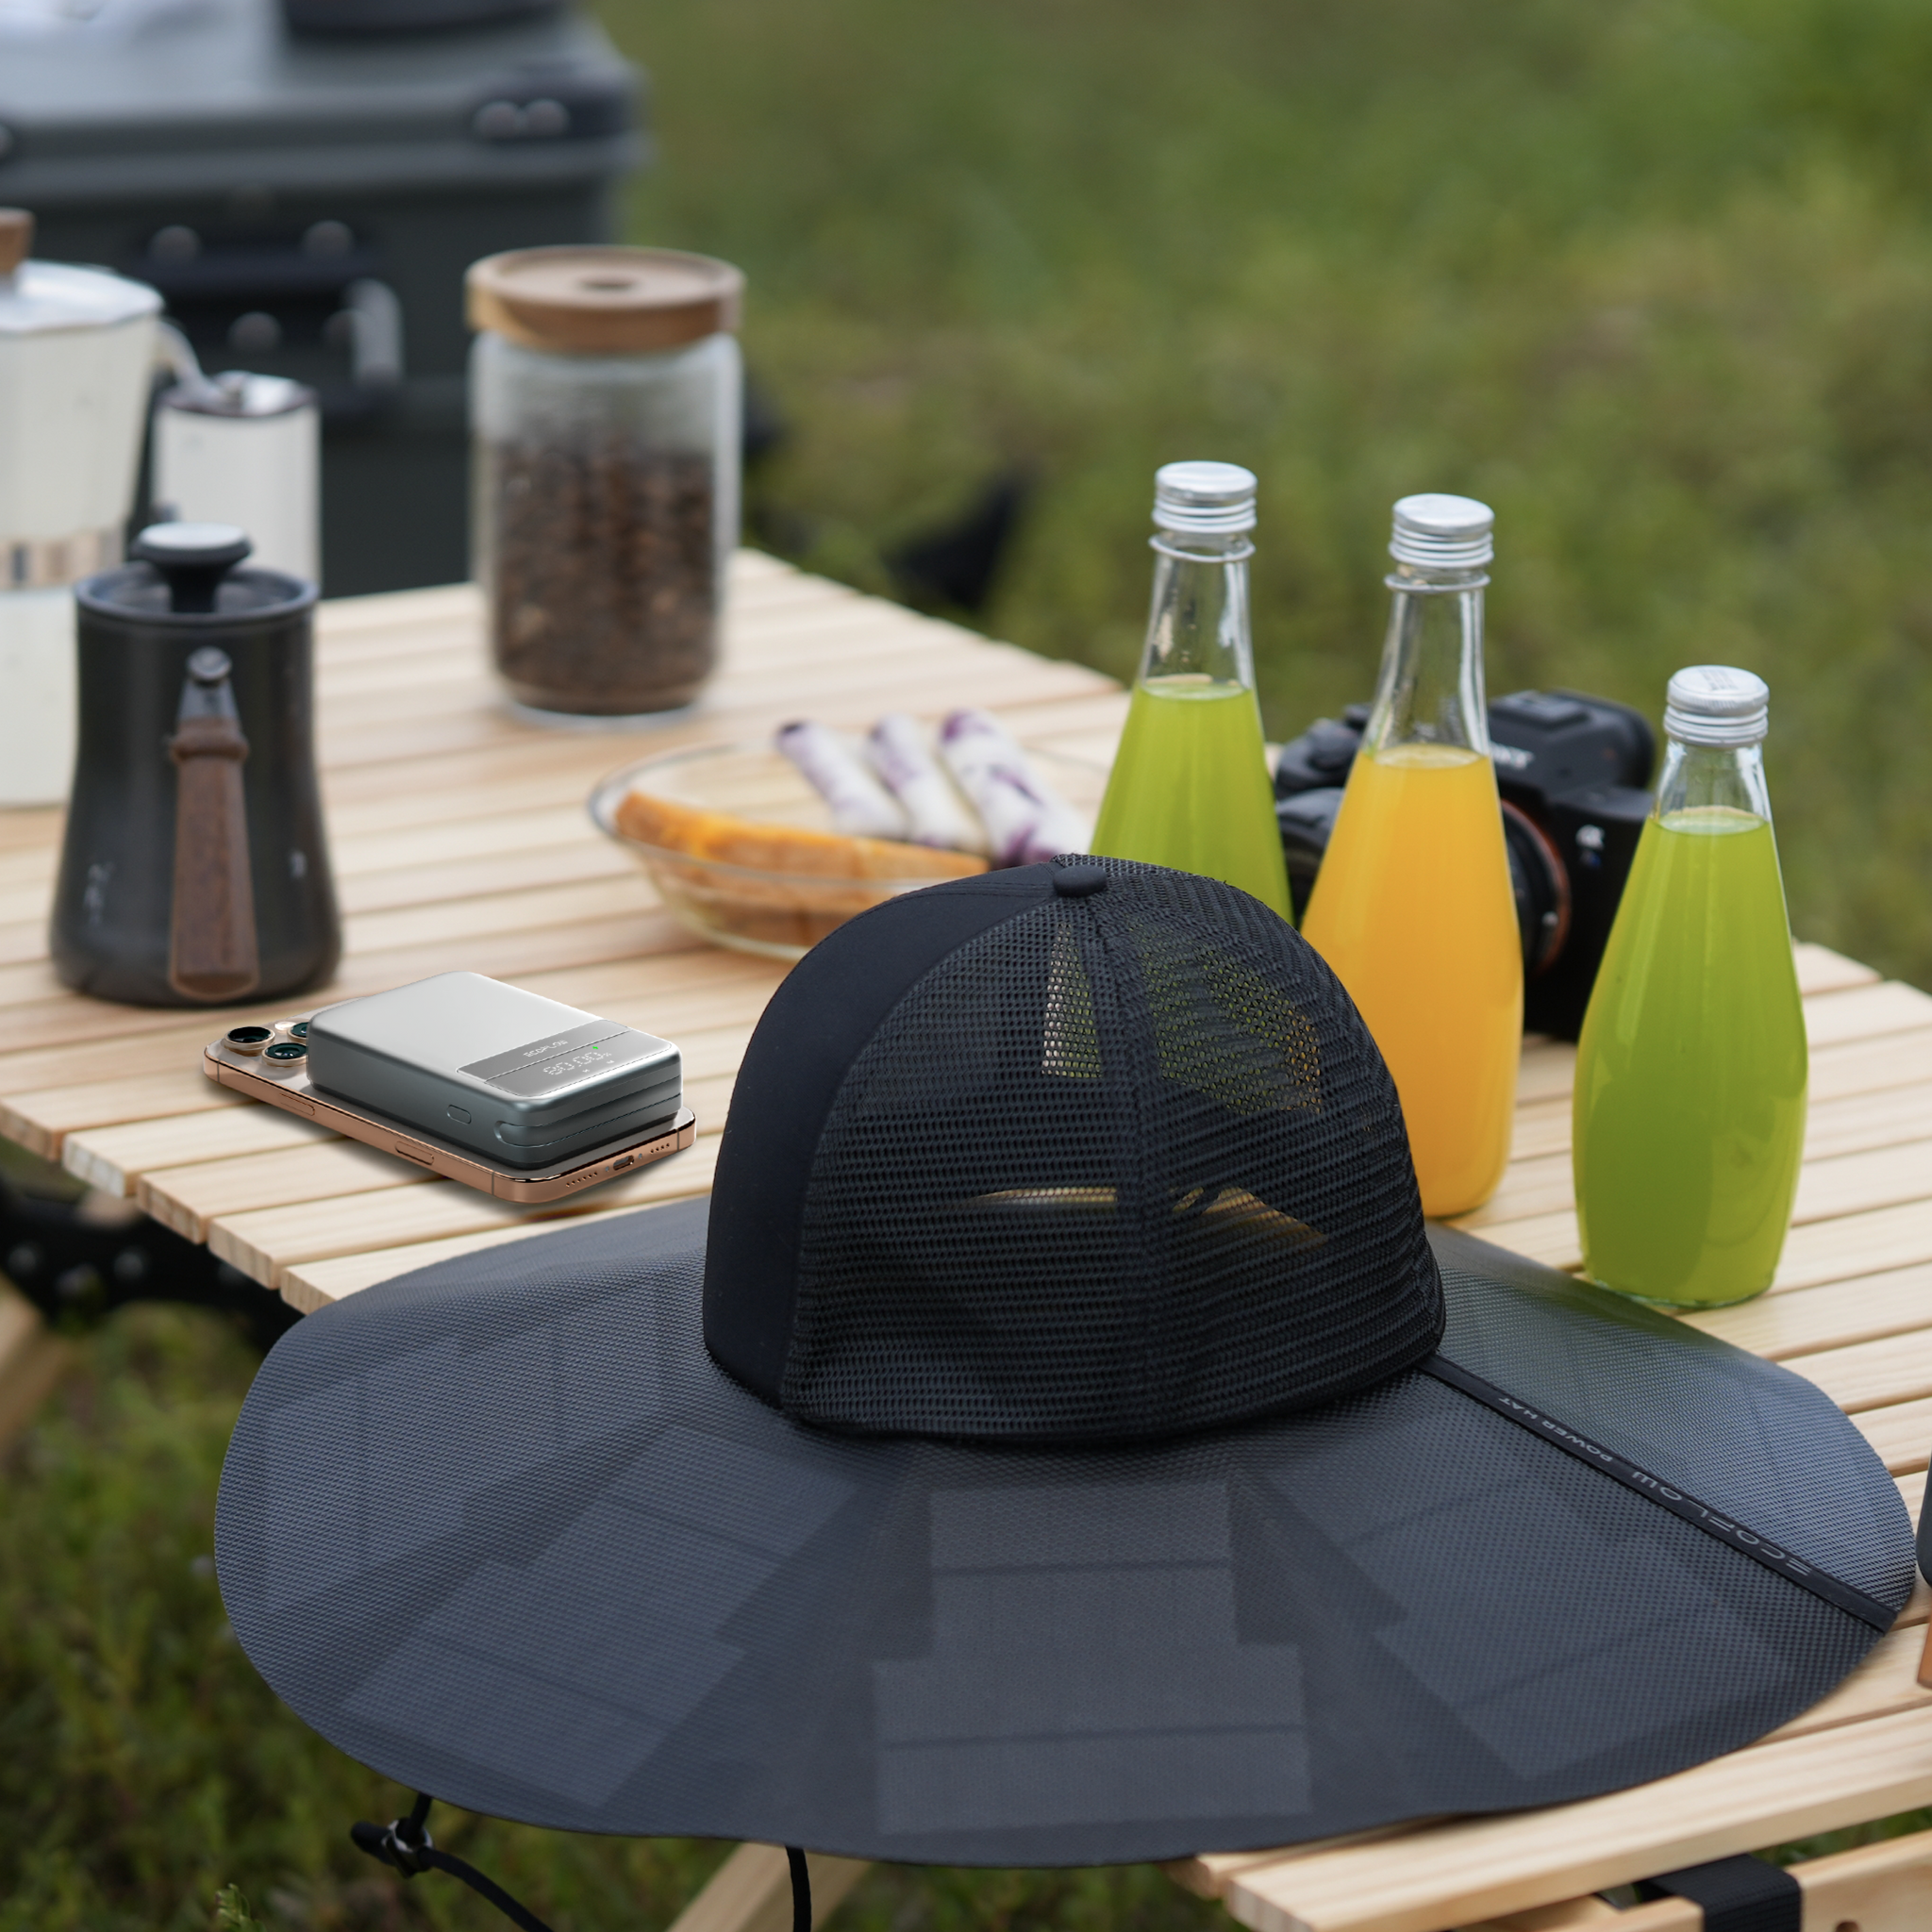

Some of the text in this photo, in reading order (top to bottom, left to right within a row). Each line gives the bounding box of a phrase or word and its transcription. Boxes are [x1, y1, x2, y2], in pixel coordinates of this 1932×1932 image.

[1498, 1397, 1812, 1576] ECOFLOW POWER HAT
